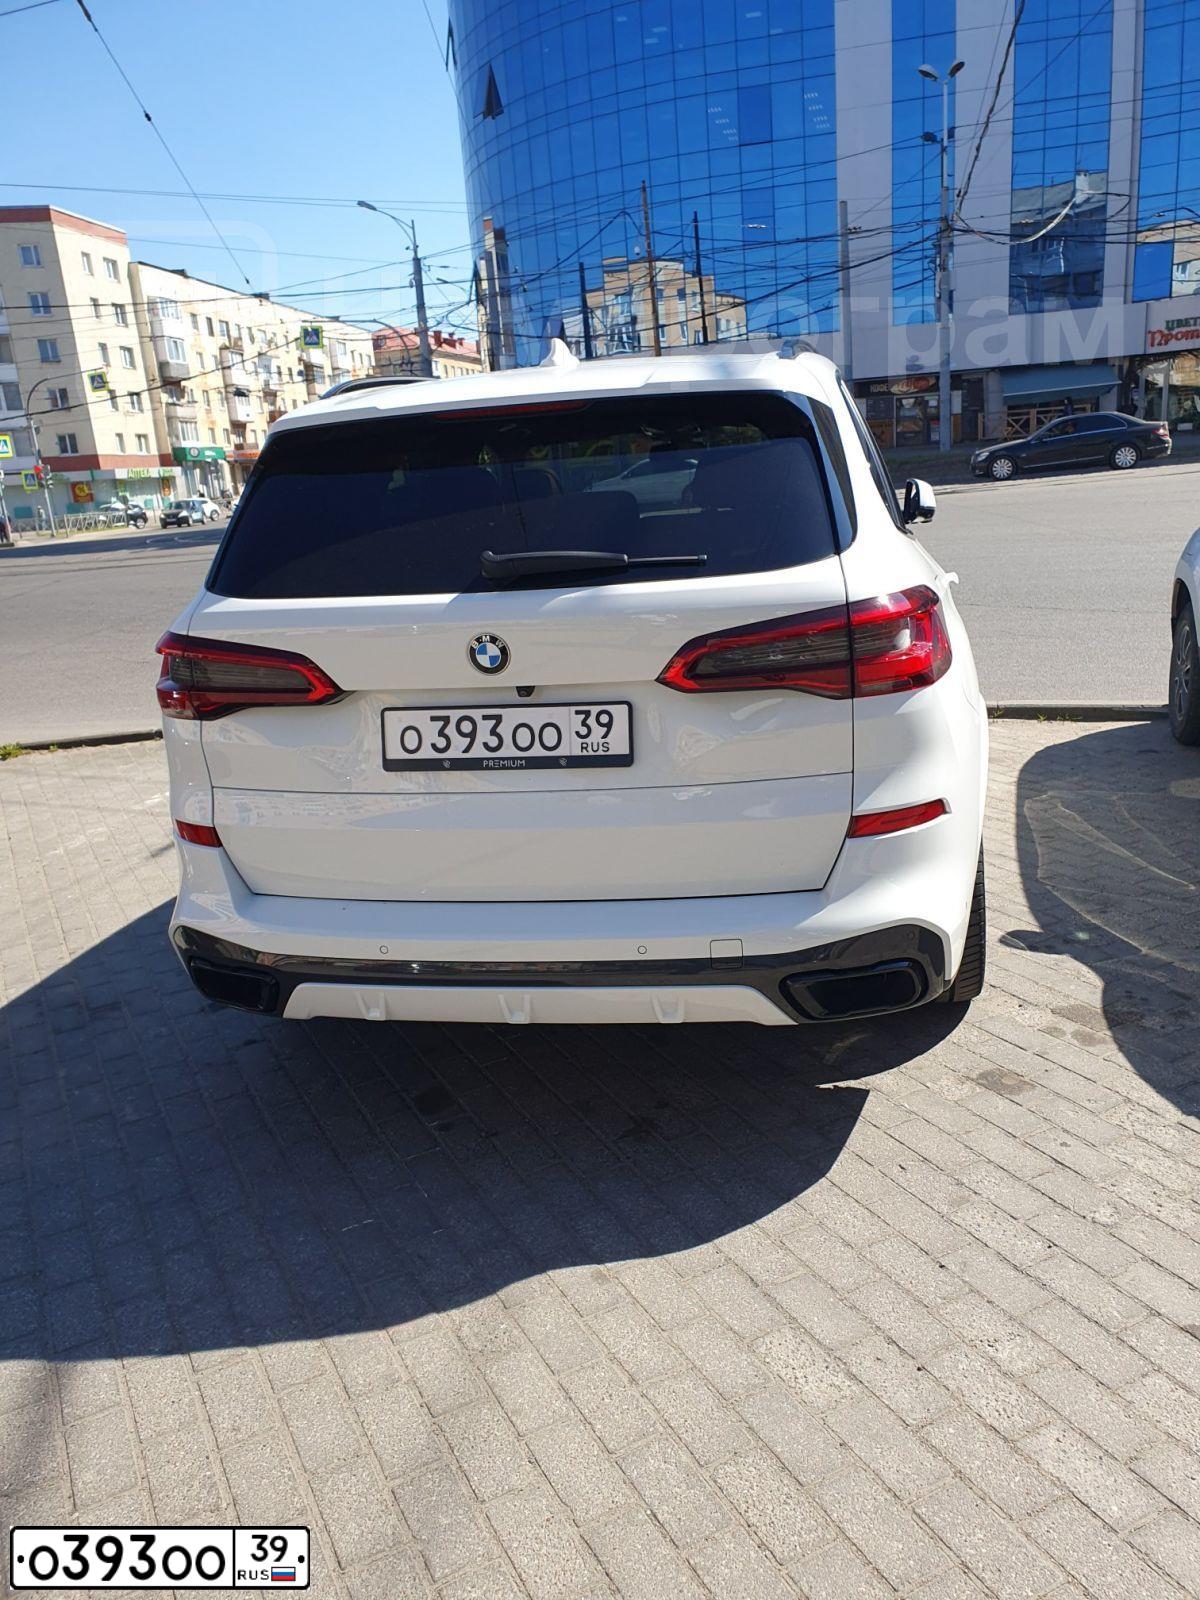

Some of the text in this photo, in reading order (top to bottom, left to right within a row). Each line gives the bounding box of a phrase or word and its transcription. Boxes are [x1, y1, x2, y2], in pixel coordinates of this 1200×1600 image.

[1165, 317, 1200, 330] ЦВЕТ
[1148, 330, 1200, 347] Прот
[471, 635, 504, 648] BMW
[574, 709, 614, 740] 39
[580, 741, 610, 753] RUS
[483, 759, 526, 768] PREMIUM
